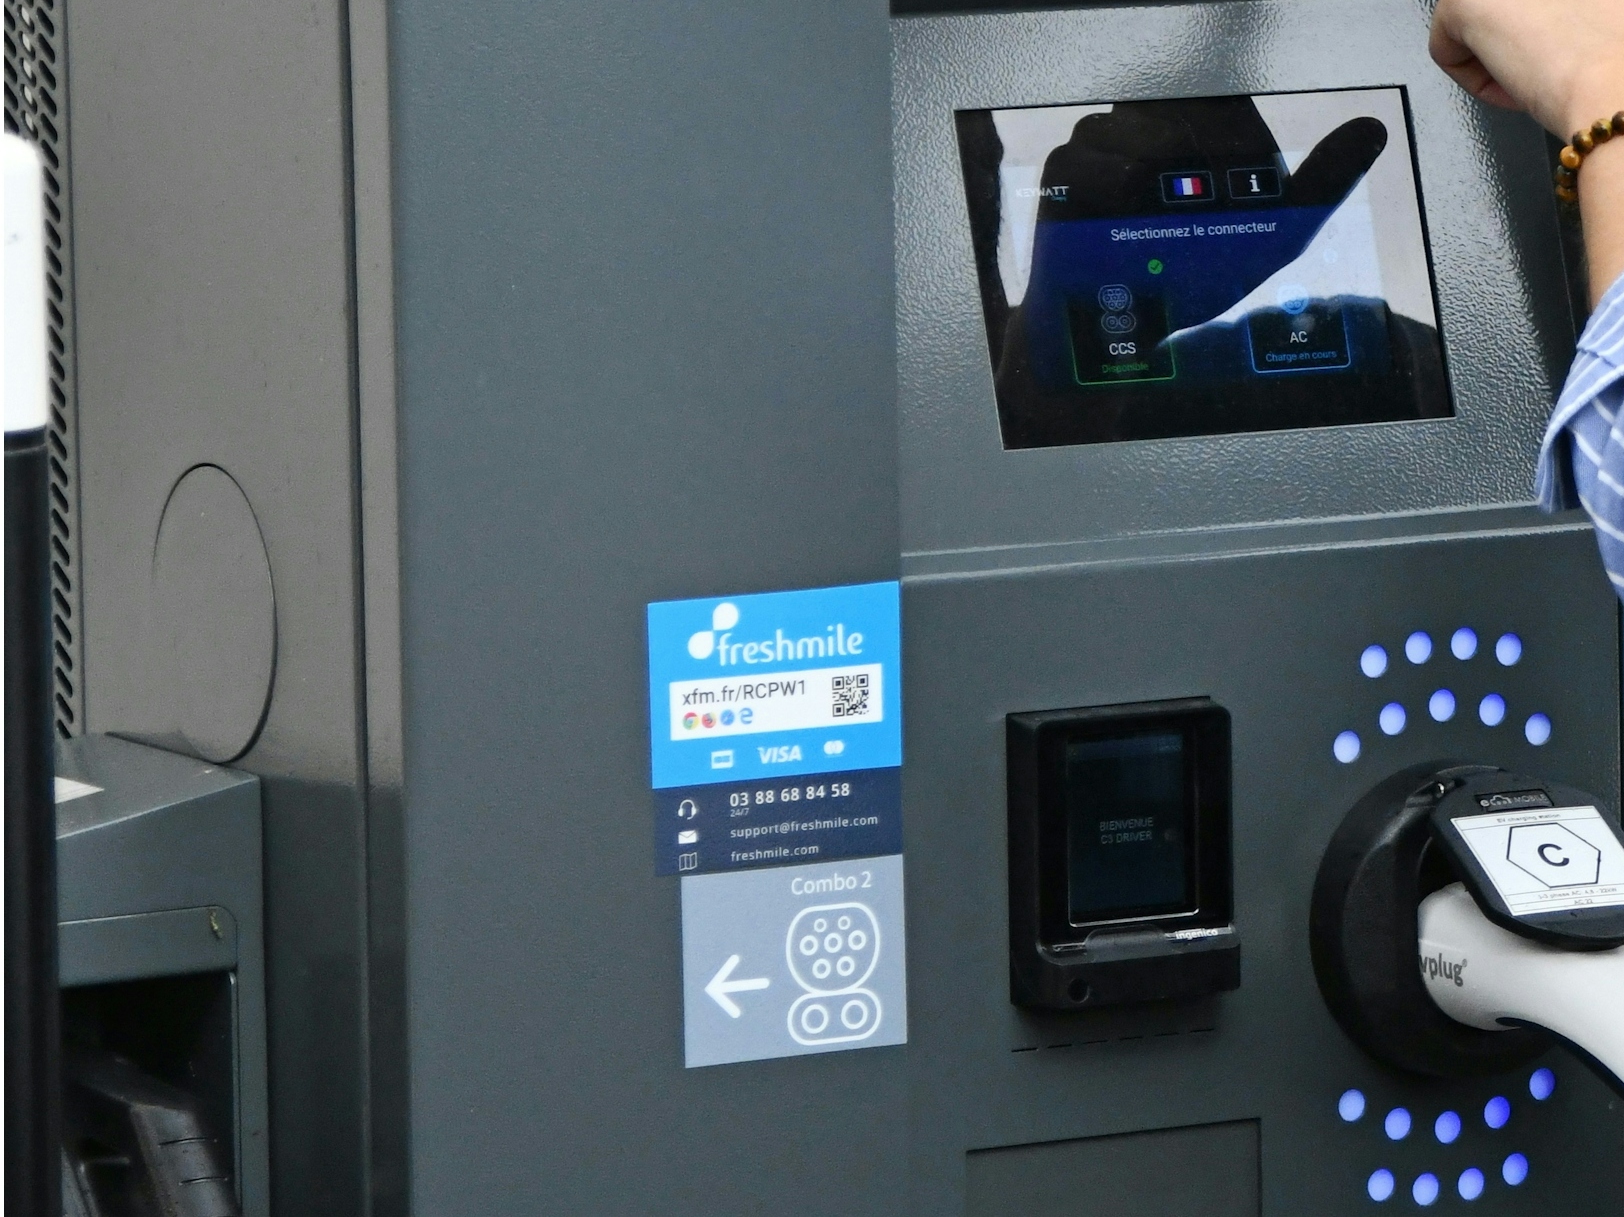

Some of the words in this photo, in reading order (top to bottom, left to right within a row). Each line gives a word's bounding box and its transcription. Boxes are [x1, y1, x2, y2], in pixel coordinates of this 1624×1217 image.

[1015, 186, 1069, 198] KEYWATT
[1111, 228, 1190, 242] Sélectionnez
[1193, 227, 1205, 236] le
[1208, 222, 1277, 236] connecteur
[1290, 331, 1308, 343] AC
[1109, 342, 1136, 355] CCS
[1266, 352, 1296, 363] Charge
[1312, 351, 1336, 359] cours
[1102, 362, 1148, 373] Disponible
[717, 623, 863, 666] freshmile
[682, 680, 805, 706] xfm.fr/RCPW1
[757, 745, 802, 764] VISA
[730, 792, 749, 807] 03
[755, 790, 774, 804] 88
[781, 788, 799, 802] 68
[806, 785, 825, 799] 84
[831, 783, 850, 797] 58
[730, 808, 749, 817] 24/7
[730, 816, 878, 839] support@freshmile.com
[1100, 817, 1154, 831] BIENVENUE
[1116, 831, 1153, 843] DRIVER
[731, 845, 819, 861] freshmile.com
[1537, 843, 1569, 867] C
[792, 873, 857, 895] Combo
[861, 871, 872, 887] 2
[1176, 928, 1218, 940] ingenico
